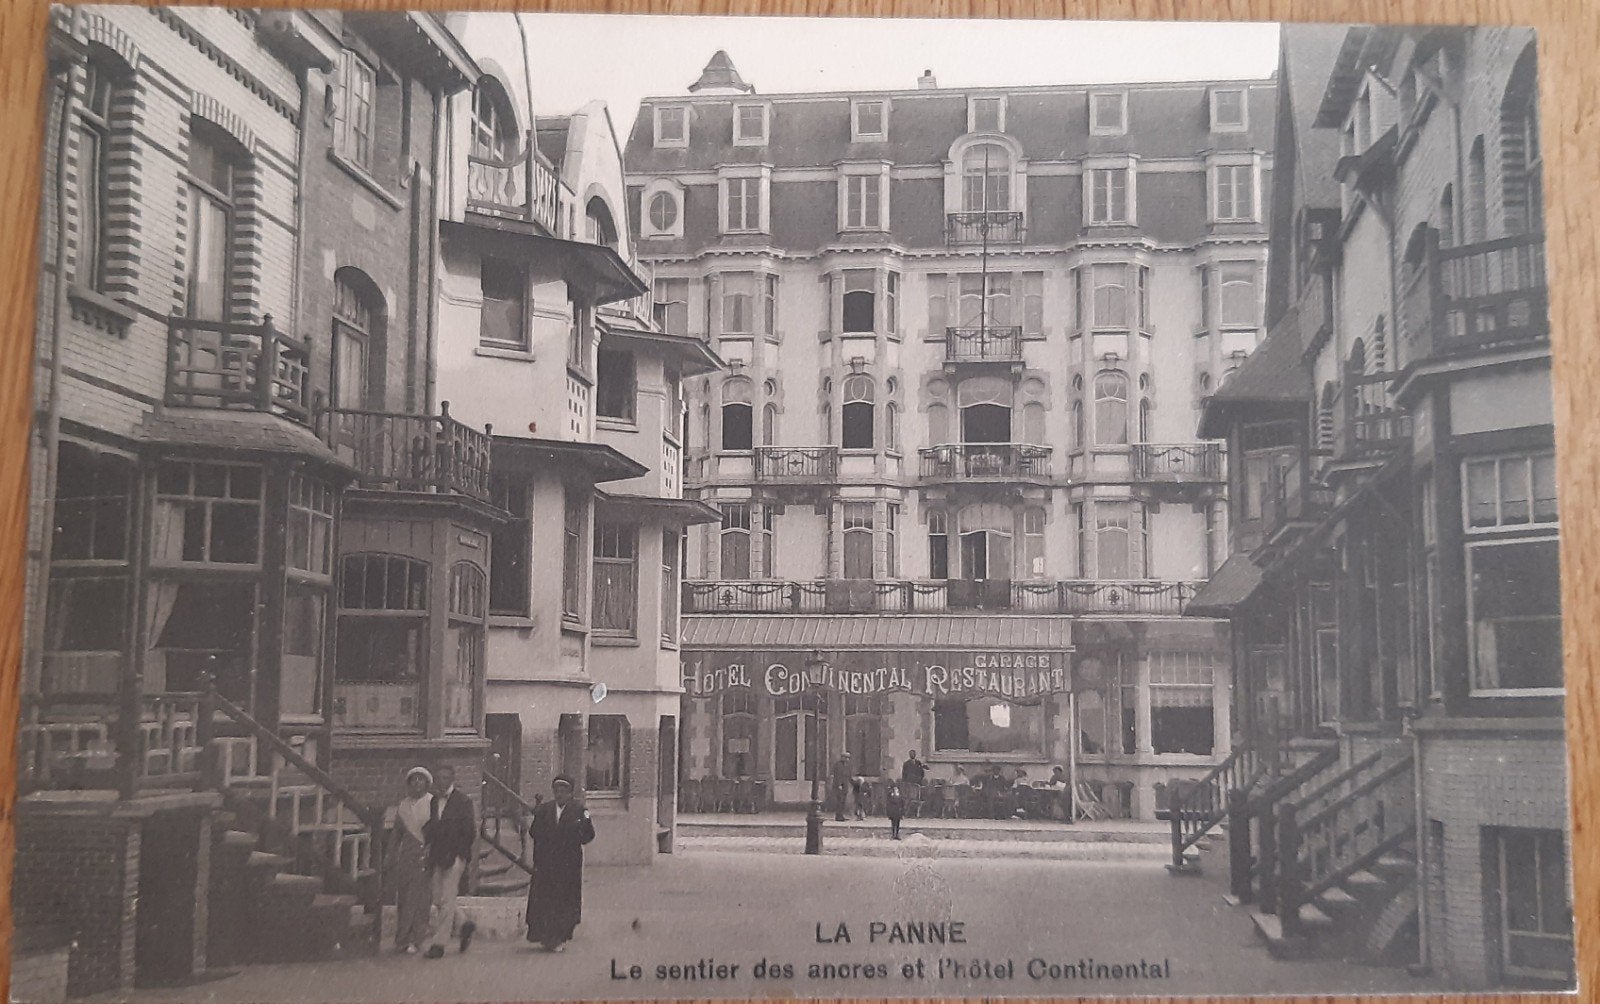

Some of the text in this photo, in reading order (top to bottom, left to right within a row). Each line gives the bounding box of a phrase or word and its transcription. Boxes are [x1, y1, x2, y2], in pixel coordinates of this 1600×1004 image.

[975, 655, 1050, 668] GARAGE
[765, 663, 912, 696] CONINENTAL
[925, 664, 1063, 697] RESTAURANT
[815, 921, 967, 944] LA PANNE
[610, 958, 642, 980] Le
[655, 957, 740, 980] sentier
[753, 957, 795, 980] des
[901, 957, 925, 979] et
[938, 957, 1014, 980] l'hôtel
[1027, 957, 1170, 981] Continental
